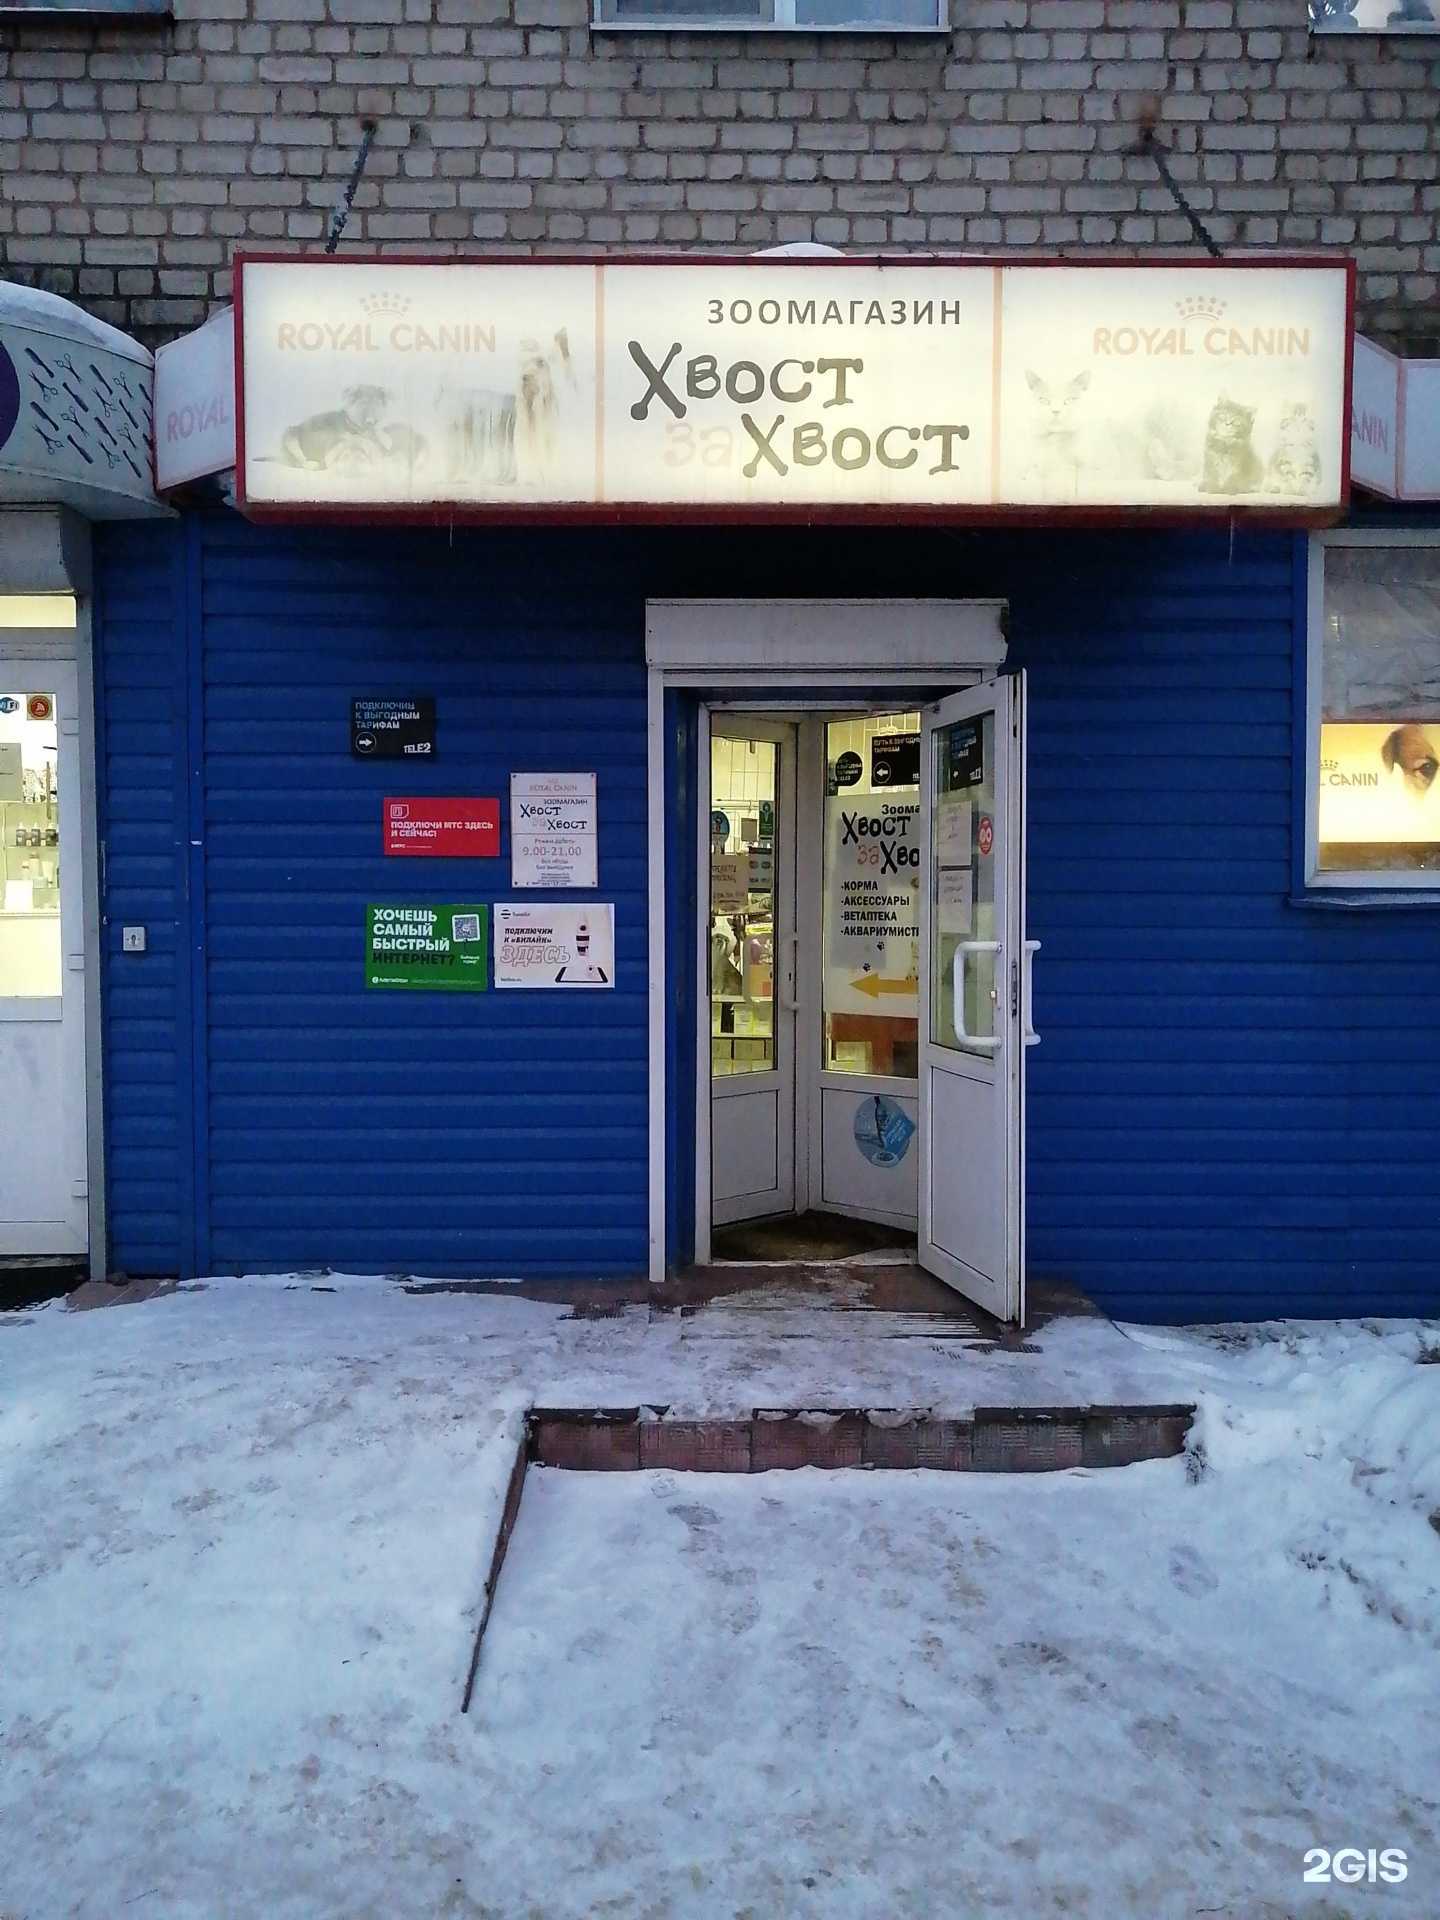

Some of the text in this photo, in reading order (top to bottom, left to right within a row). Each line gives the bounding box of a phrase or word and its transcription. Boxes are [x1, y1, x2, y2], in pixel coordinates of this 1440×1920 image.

[707, 299, 961, 325] ЗООМАГАЗИН
[277, 322, 497, 353] ROYAL CANIN
[1093, 327, 1311, 356] ROYAL CANIN
[167, 396, 228, 443] ROYAL
[404, 742, 432, 753] TELE2
[1329, 773, 1378, 786] CANIN
[857, 845, 879, 865] за
[374, 909, 438, 922] ХОЧЕШЬ
[373, 923, 433, 936] САМЫЙ
[372, 937, 450, 951] БЫСТРЫЙ
[500, 945, 571, 967] ЗДЕСЬ
